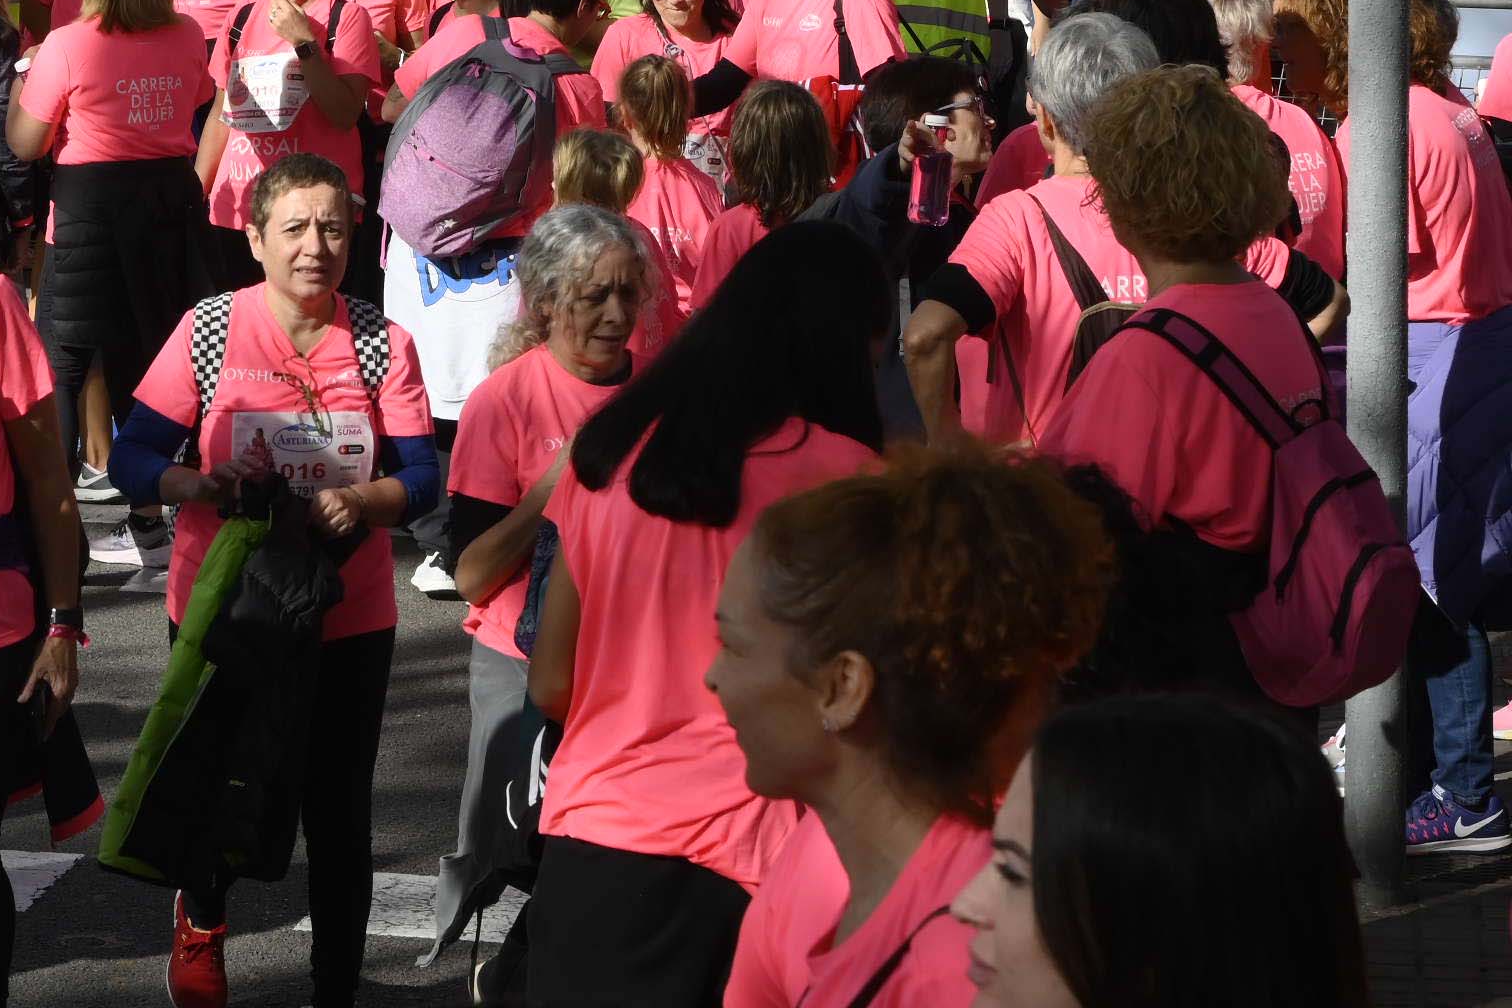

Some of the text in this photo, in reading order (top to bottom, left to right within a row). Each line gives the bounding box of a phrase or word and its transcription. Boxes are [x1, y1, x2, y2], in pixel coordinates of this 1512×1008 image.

[116, 76, 183, 94] CARRERA
[131, 91, 173, 108] DE LA
[128, 107, 175, 126] MUJER
[1301, 174, 1322, 191] LA
[280, 462, 326, 480] 016
